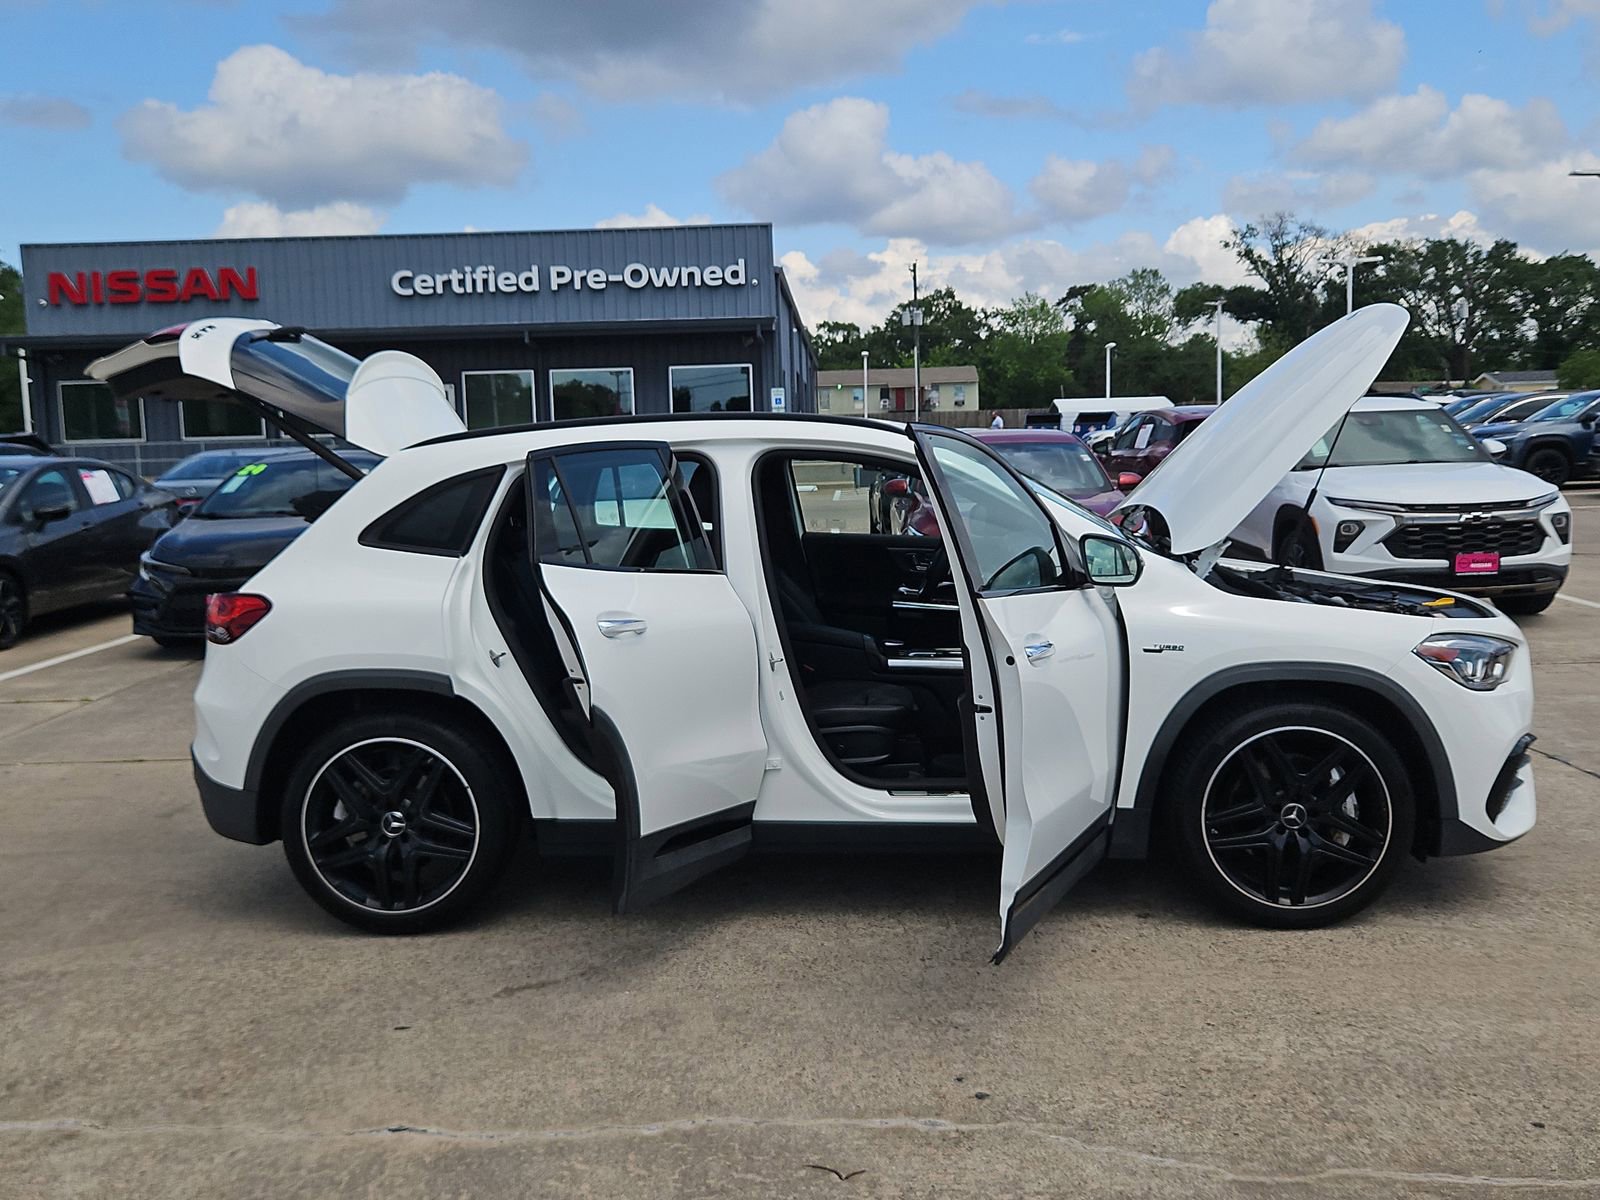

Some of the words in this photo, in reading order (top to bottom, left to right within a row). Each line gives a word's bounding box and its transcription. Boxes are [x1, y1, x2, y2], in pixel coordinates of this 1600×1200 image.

[48, 266, 258, 305] NISSAN
[391, 264, 540, 296] Certified
[550, 258, 746, 291] Pre-Owned
